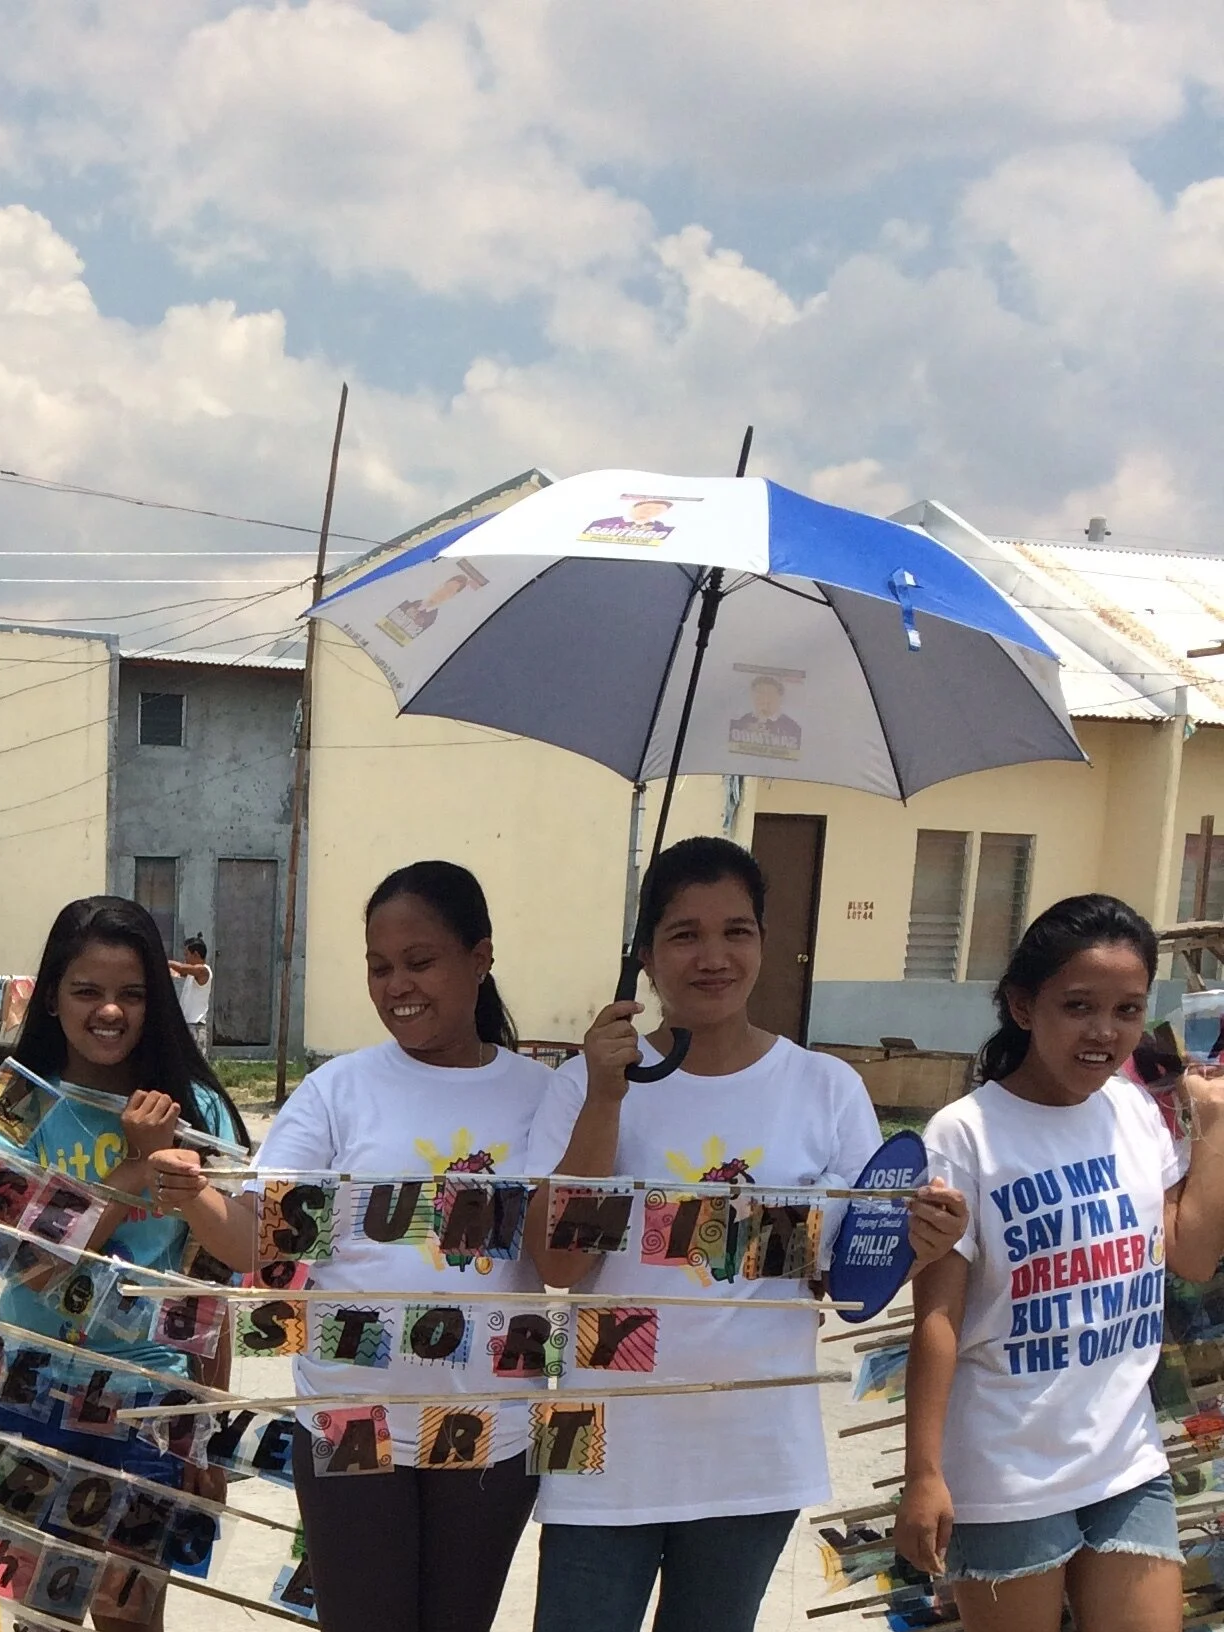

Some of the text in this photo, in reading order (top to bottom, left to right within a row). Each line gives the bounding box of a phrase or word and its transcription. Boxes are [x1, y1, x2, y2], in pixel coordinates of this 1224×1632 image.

[864, 1167, 914, 1189] JOSIE
[990, 1154, 1121, 1223] YOU MAY
[845, 1254, 894, 1267] SALVADOR
[847, 1234, 900, 1256] PHILLIP
[1003, 1194, 1140, 1263] SAY I'M A
[1011, 1234, 1146, 1300] DREAMER
[1010, 1268, 1164, 1339] BUT I'M NOT
[244, 1303, 654, 1371] STORY
[1003, 1309, 1164, 1375] THE ONLY ON
[333, 1409, 596, 1474] ART
